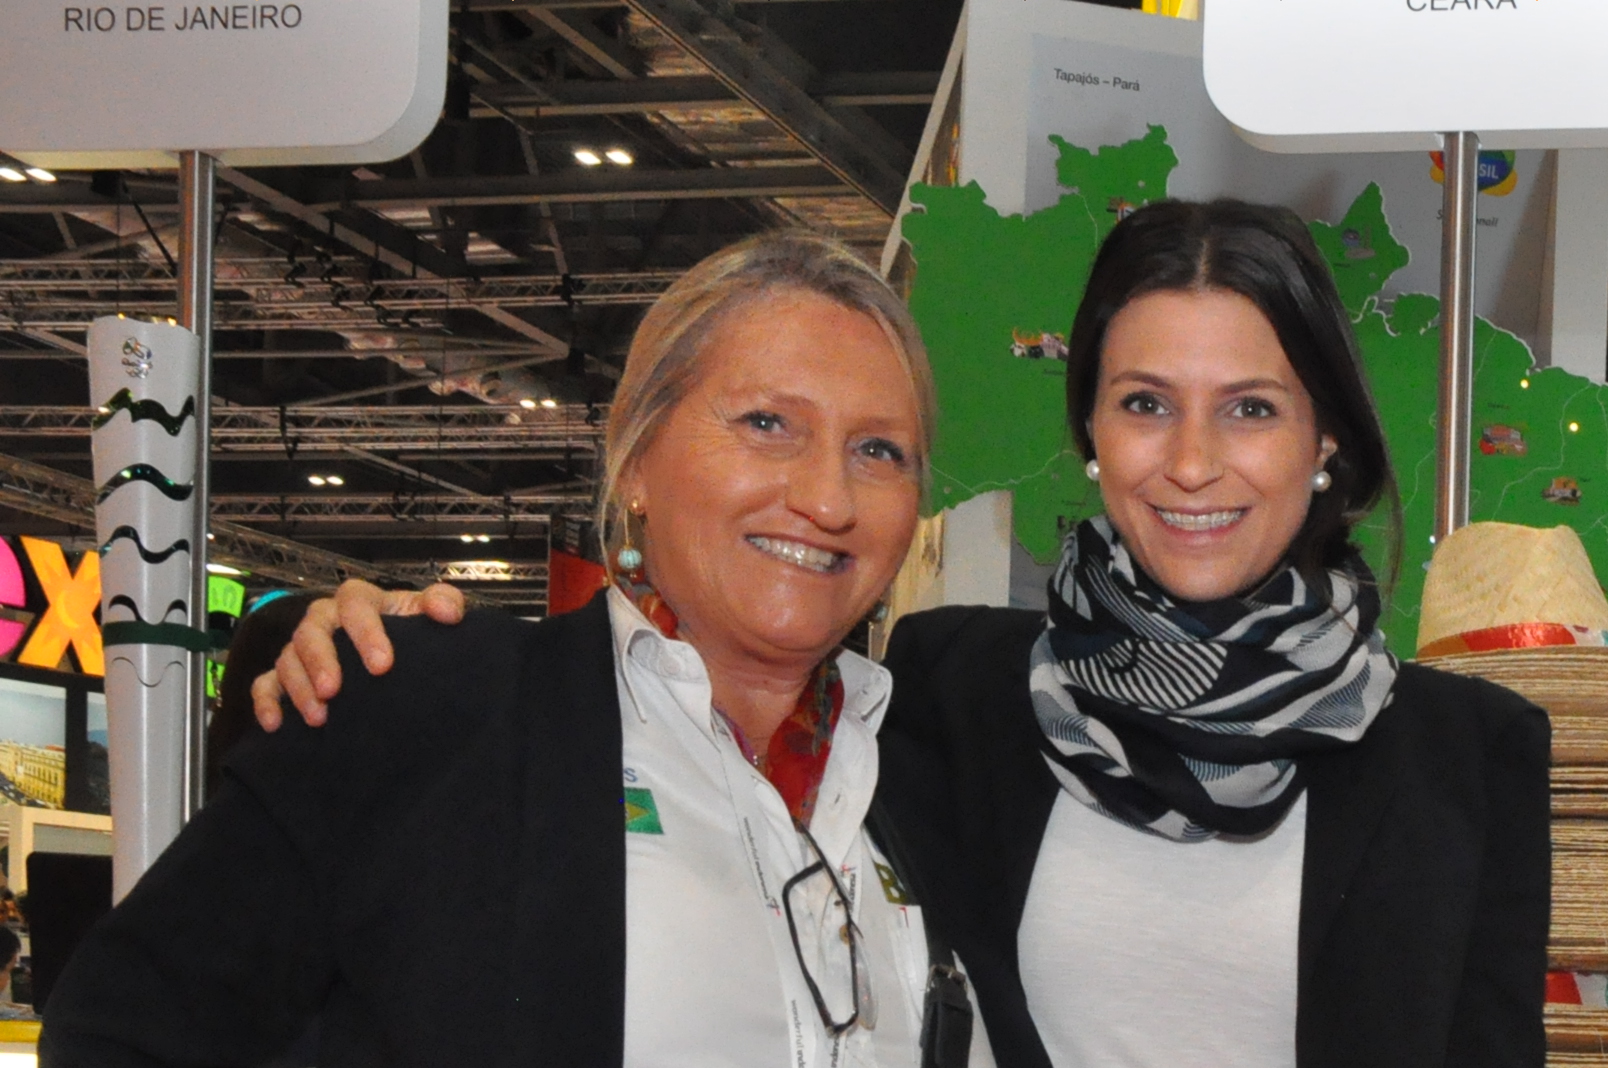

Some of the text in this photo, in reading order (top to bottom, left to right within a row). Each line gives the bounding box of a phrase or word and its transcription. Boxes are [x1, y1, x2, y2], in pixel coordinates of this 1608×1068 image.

[64, 4, 302, 31] RIO DE JANEIRO
[1054, 67, 1100, 86] Tapajós
[1113, 76, 1140, 92] Pará
